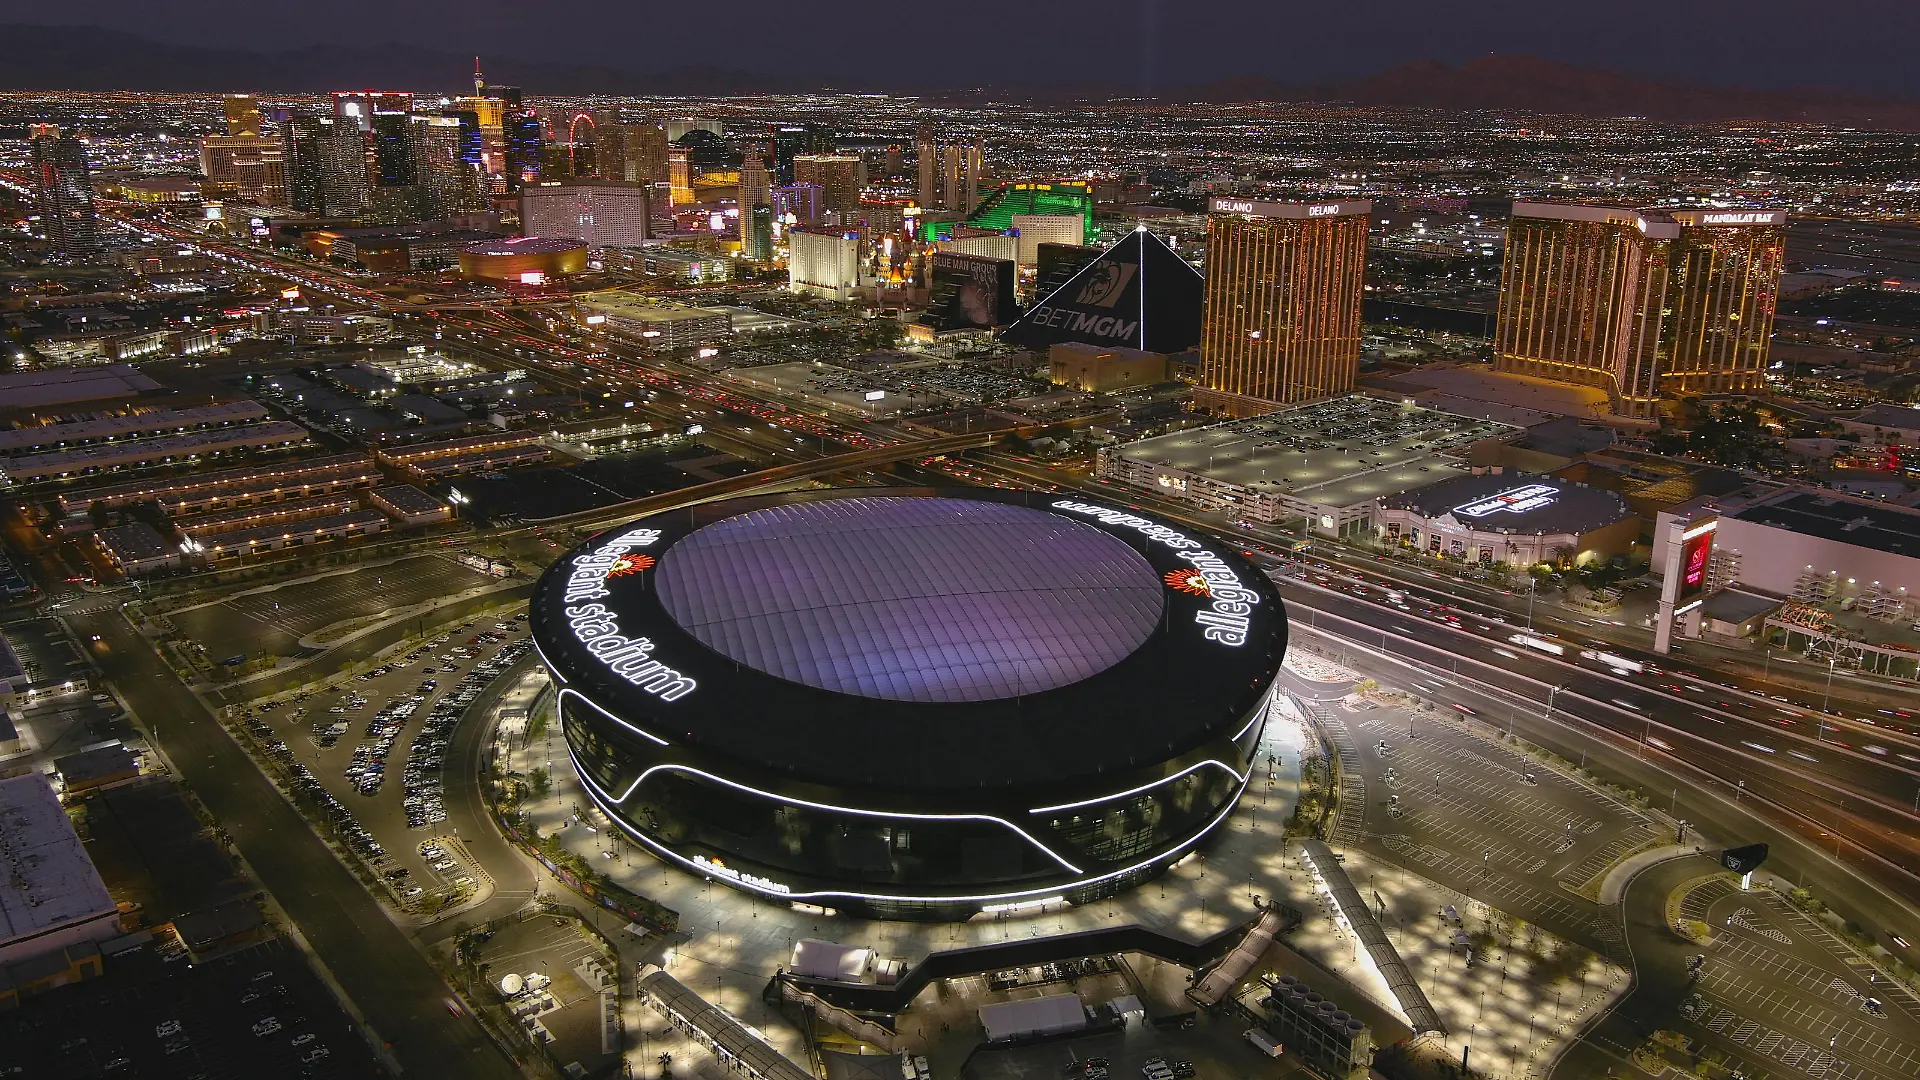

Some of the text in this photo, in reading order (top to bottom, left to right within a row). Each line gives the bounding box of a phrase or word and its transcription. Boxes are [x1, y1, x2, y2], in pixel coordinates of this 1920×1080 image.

[1216, 200, 1253, 213] DELANO
[1309, 204, 1339, 216] DELANO
[1703, 214, 1774, 223] MANDALAY BAY
[933, 256, 997, 274] BLUE MAN GROUP
[1051, 500, 1260, 646] allegiant stadium
[563, 528, 697, 702] allegiant stadium
